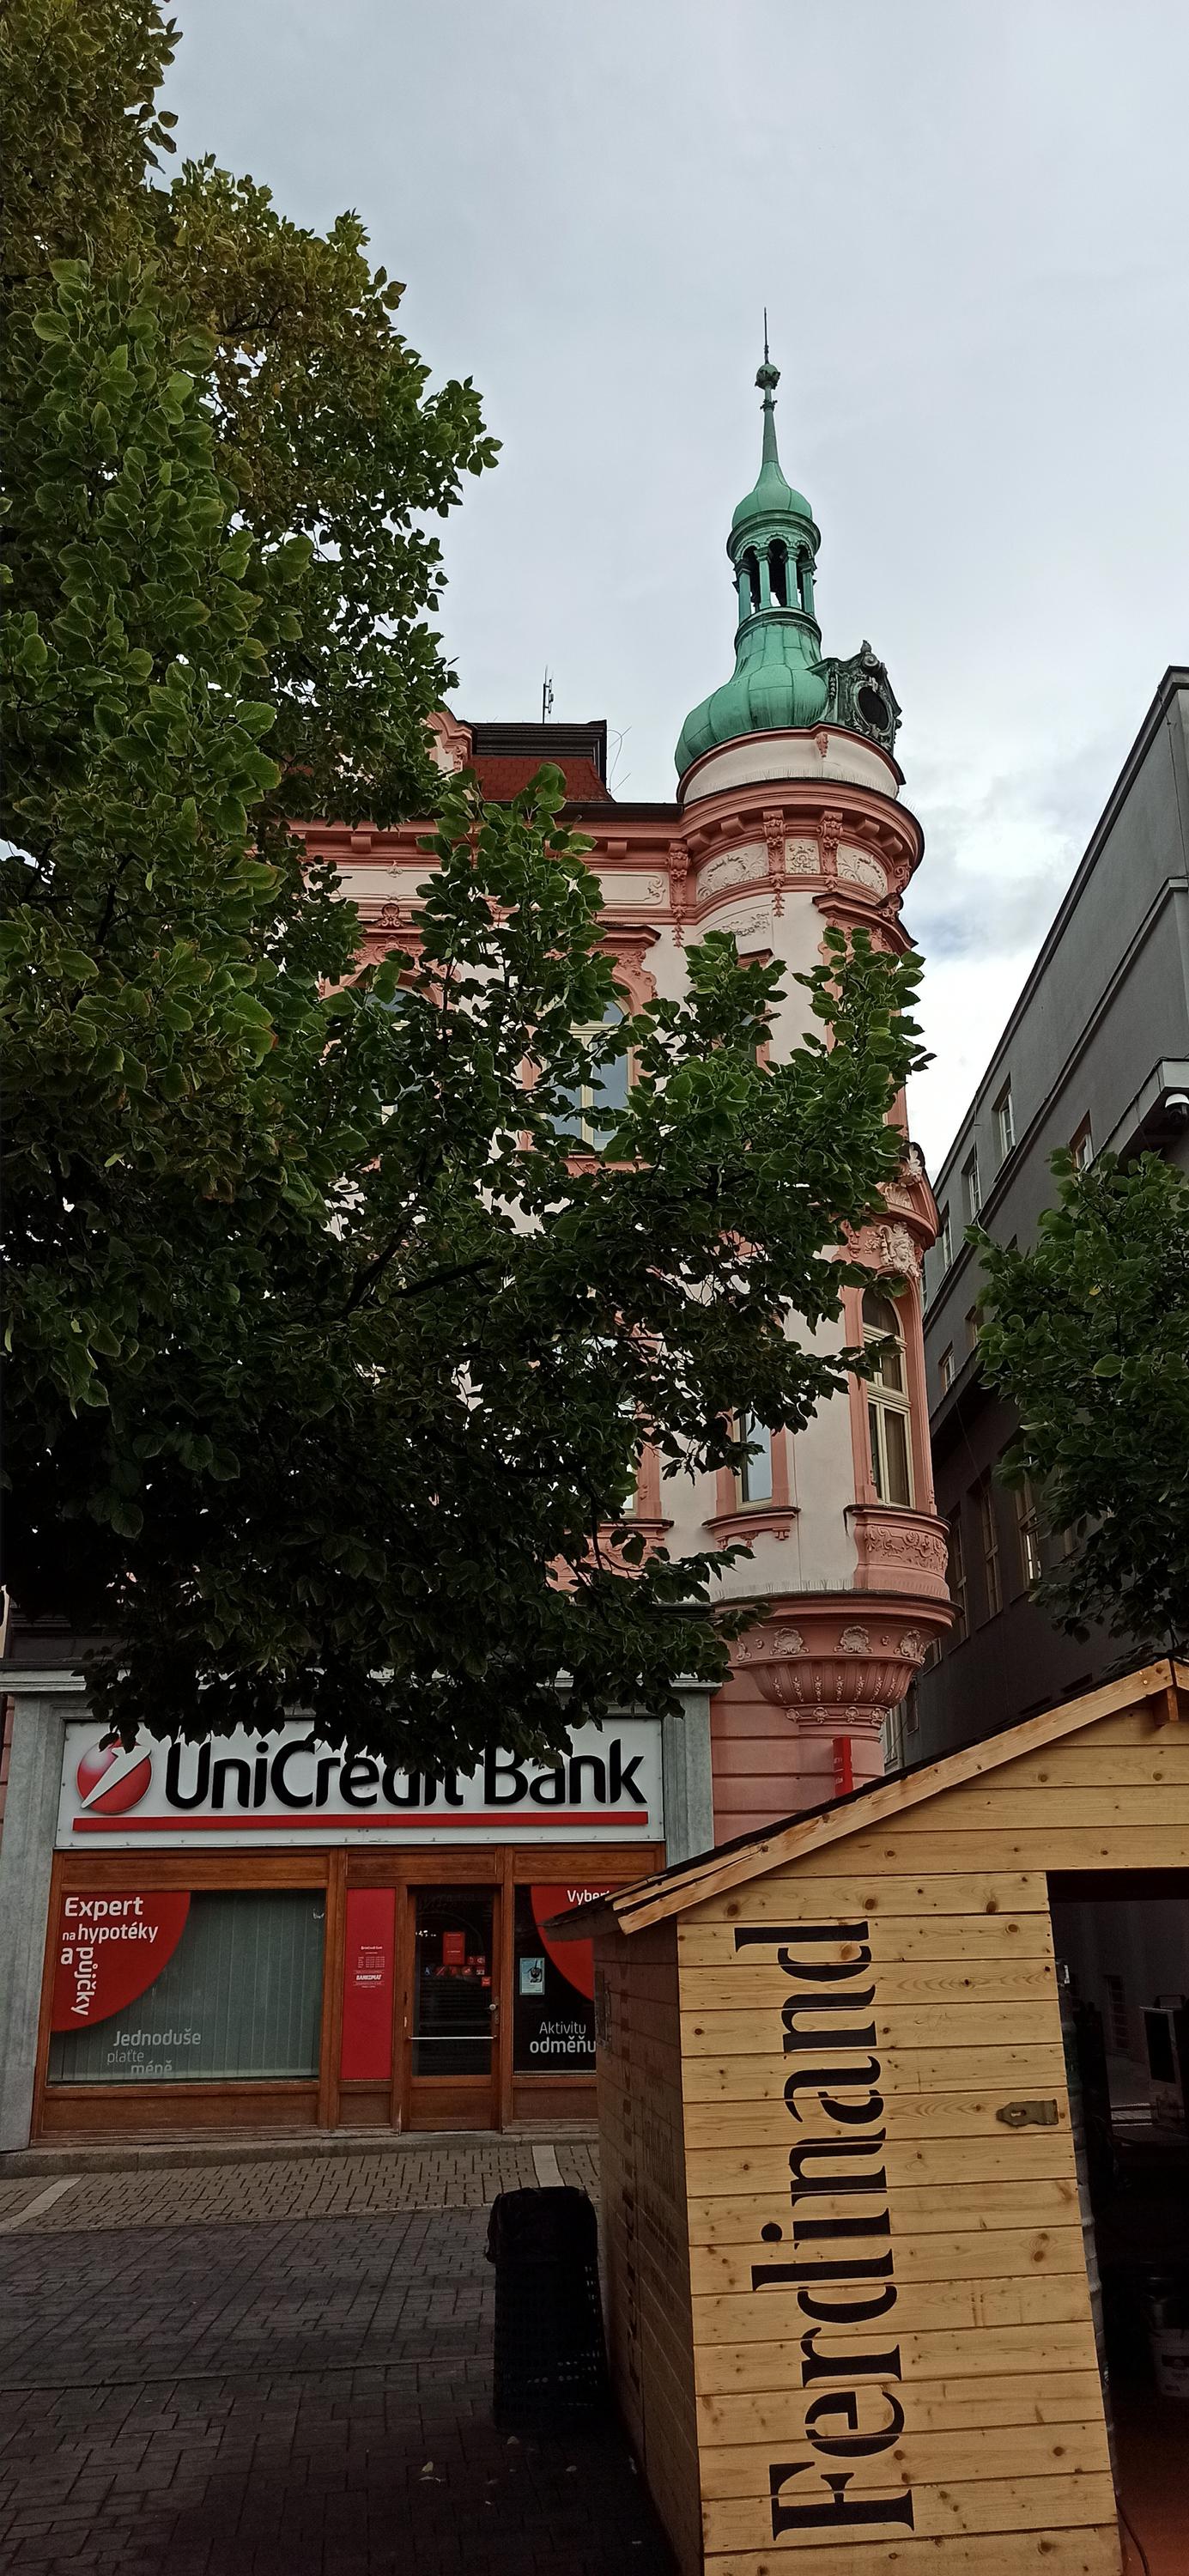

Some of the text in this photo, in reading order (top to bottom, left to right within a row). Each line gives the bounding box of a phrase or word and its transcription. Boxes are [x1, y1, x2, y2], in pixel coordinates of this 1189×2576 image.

[483, 1738, 648, 1805] Bank
[567, 1889, 610, 1905] Vybe
[64, 1896, 144, 1922] Expert
[62, 1922, 159, 1944] na hypotéky
[60, 1947, 99, 2016] a půjčky
[112, 2028, 202, 2047] Jednoduše
[539, 2020, 586, 2035] Aktivitu
[106, 2048, 145, 2065] plaťte
[130, 2059, 173, 2075] méně
[733, 1920, 915, 2541] Ferdinand
